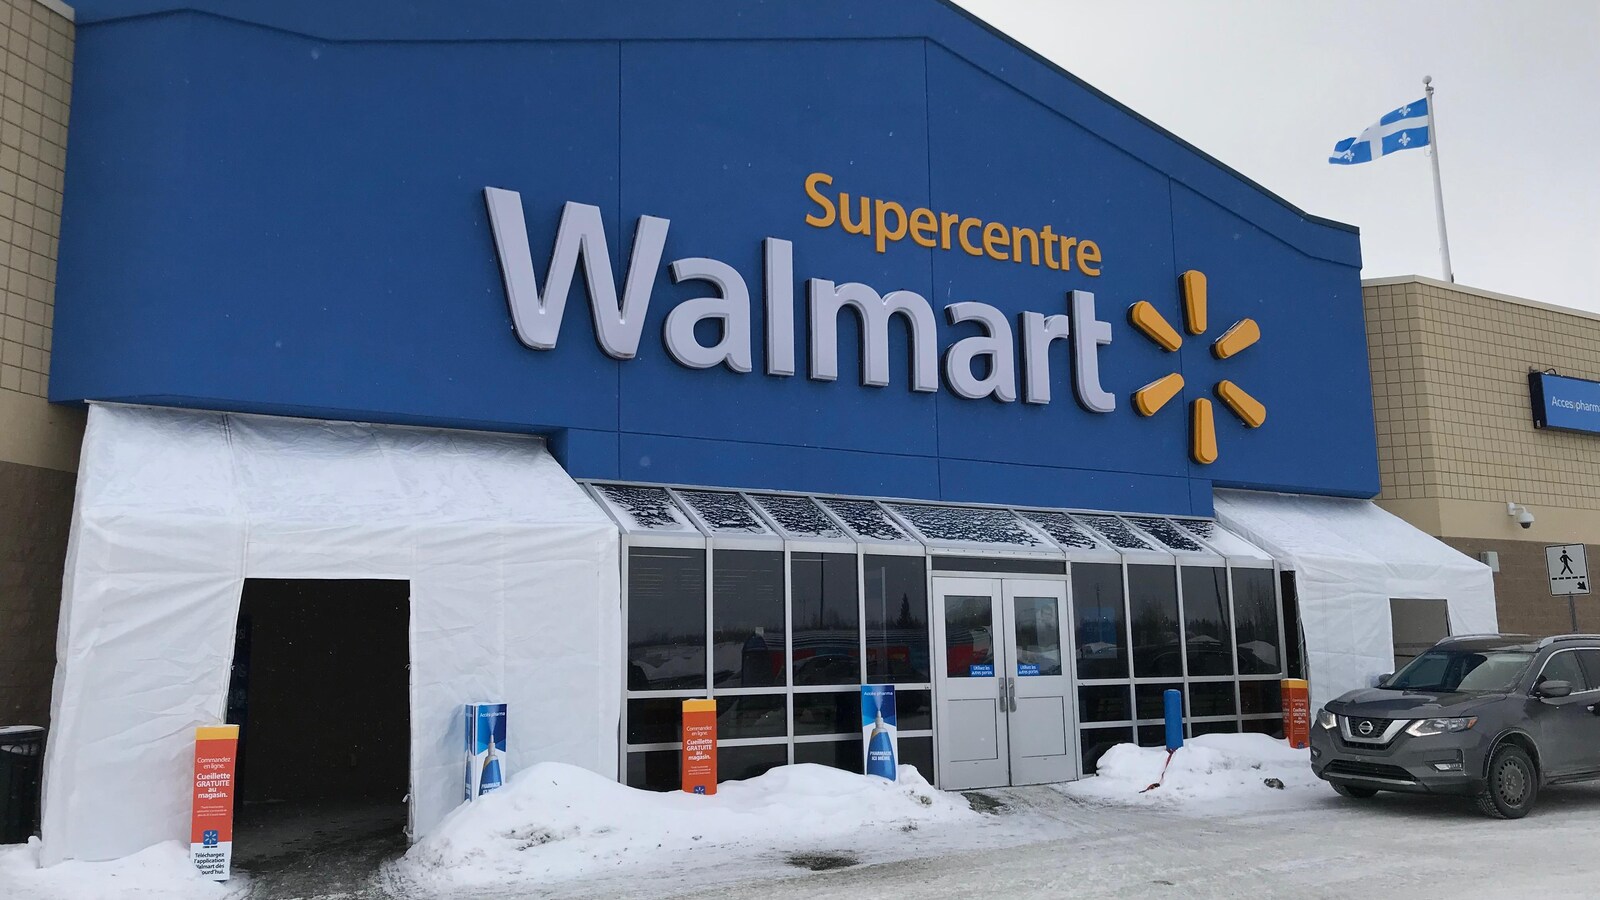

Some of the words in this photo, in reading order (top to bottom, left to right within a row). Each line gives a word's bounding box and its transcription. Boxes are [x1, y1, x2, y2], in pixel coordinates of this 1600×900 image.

[804, 171, 1103, 279] Supercentre
[483, 186, 1116, 414] Walmart
[1575, 400, 1600, 413] pharm
[196, 772, 231, 780] Cueillette
[197, 791, 228, 800] magasin.
